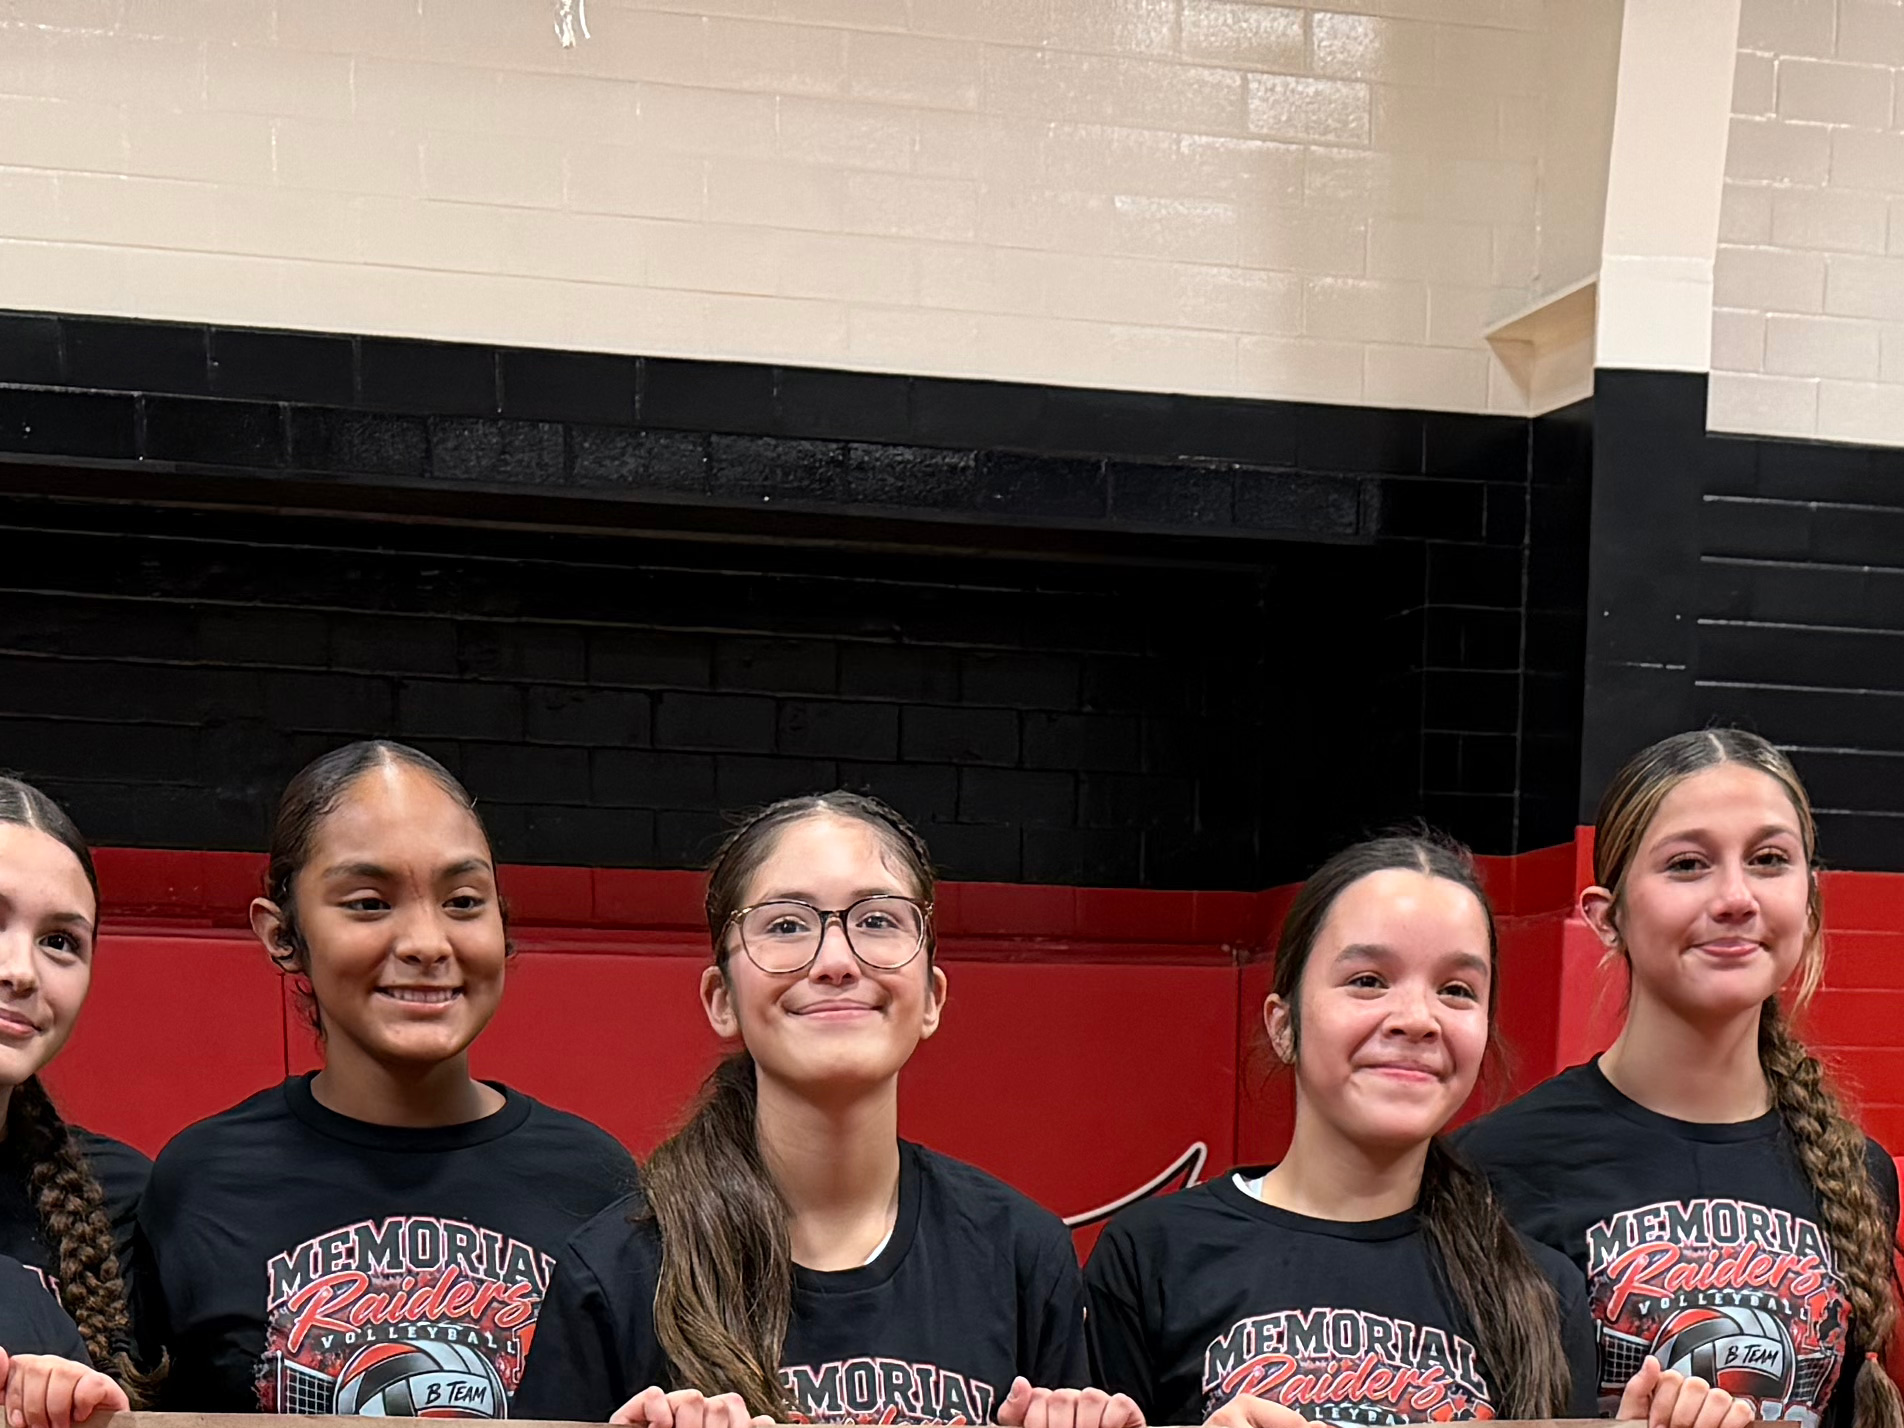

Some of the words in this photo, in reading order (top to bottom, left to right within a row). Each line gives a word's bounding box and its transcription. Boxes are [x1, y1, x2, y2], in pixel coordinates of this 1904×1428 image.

[287, 1264, 534, 1354] Raiders
[1607, 1241, 1822, 1323] Raiders
[321, 1325, 516, 1355] VOLLEYBALL
[1202, 1307, 1492, 1400] MEMORIAL
[1725, 1345, 1741, 1367] B
[1744, 1343, 1779, 1368] TEAM
[426, 1383, 441, 1405] B
[447, 1381, 487, 1404] TEAM
[779, 1357, 995, 1426] MORIAL
